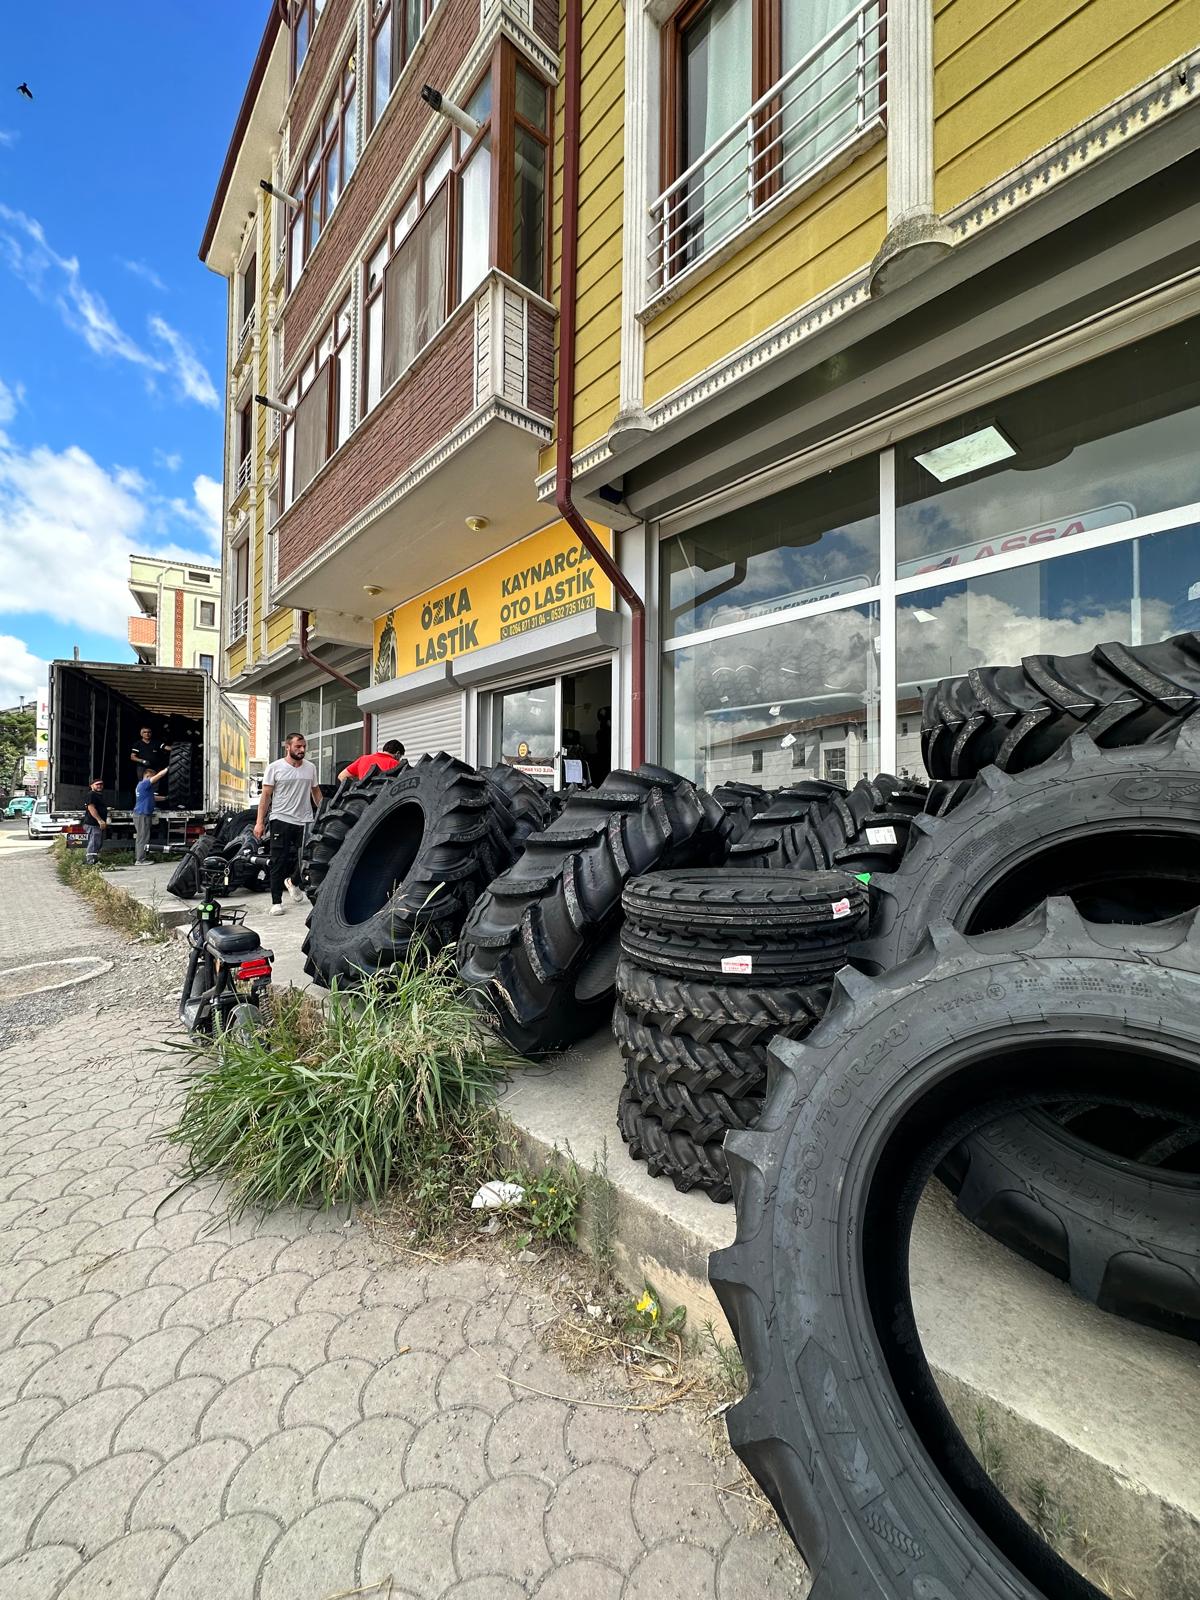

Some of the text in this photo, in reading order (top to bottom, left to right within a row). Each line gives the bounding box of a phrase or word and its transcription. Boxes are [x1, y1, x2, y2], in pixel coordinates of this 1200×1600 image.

[501, 568, 594, 622] OTO LASTİK
[502, 544, 592, 598] KAYNARCA
[421, 587, 471, 630] ÖZKA
[566, 603, 576, 615] 735
[416, 619, 478, 667] LASTİK
